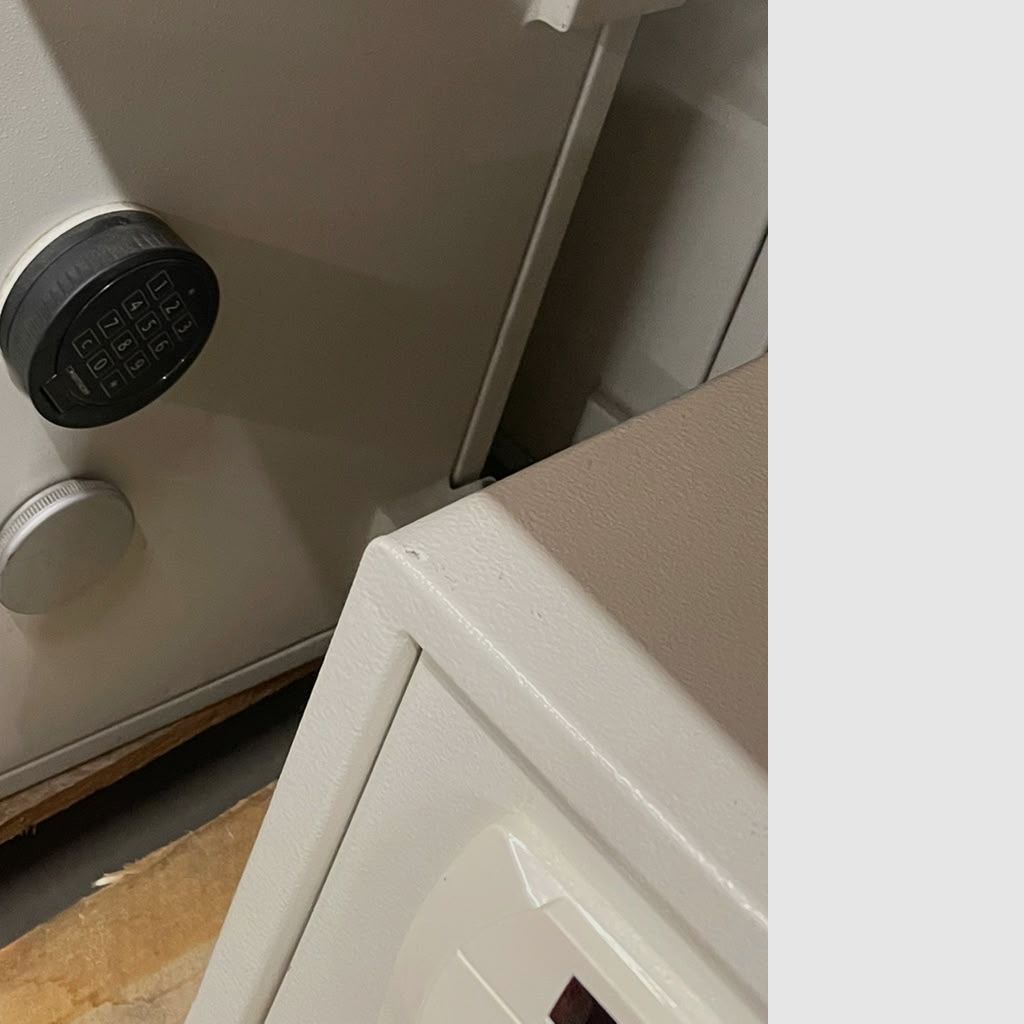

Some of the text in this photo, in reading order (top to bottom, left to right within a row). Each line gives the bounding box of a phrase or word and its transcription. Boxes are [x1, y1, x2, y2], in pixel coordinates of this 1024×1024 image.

[129, 300, 169, 353] 4 5 6
[154, 279, 192, 334] 1 2 3
[93, 358, 108, 371] 0
[104, 317, 145, 372] 7 8 9
